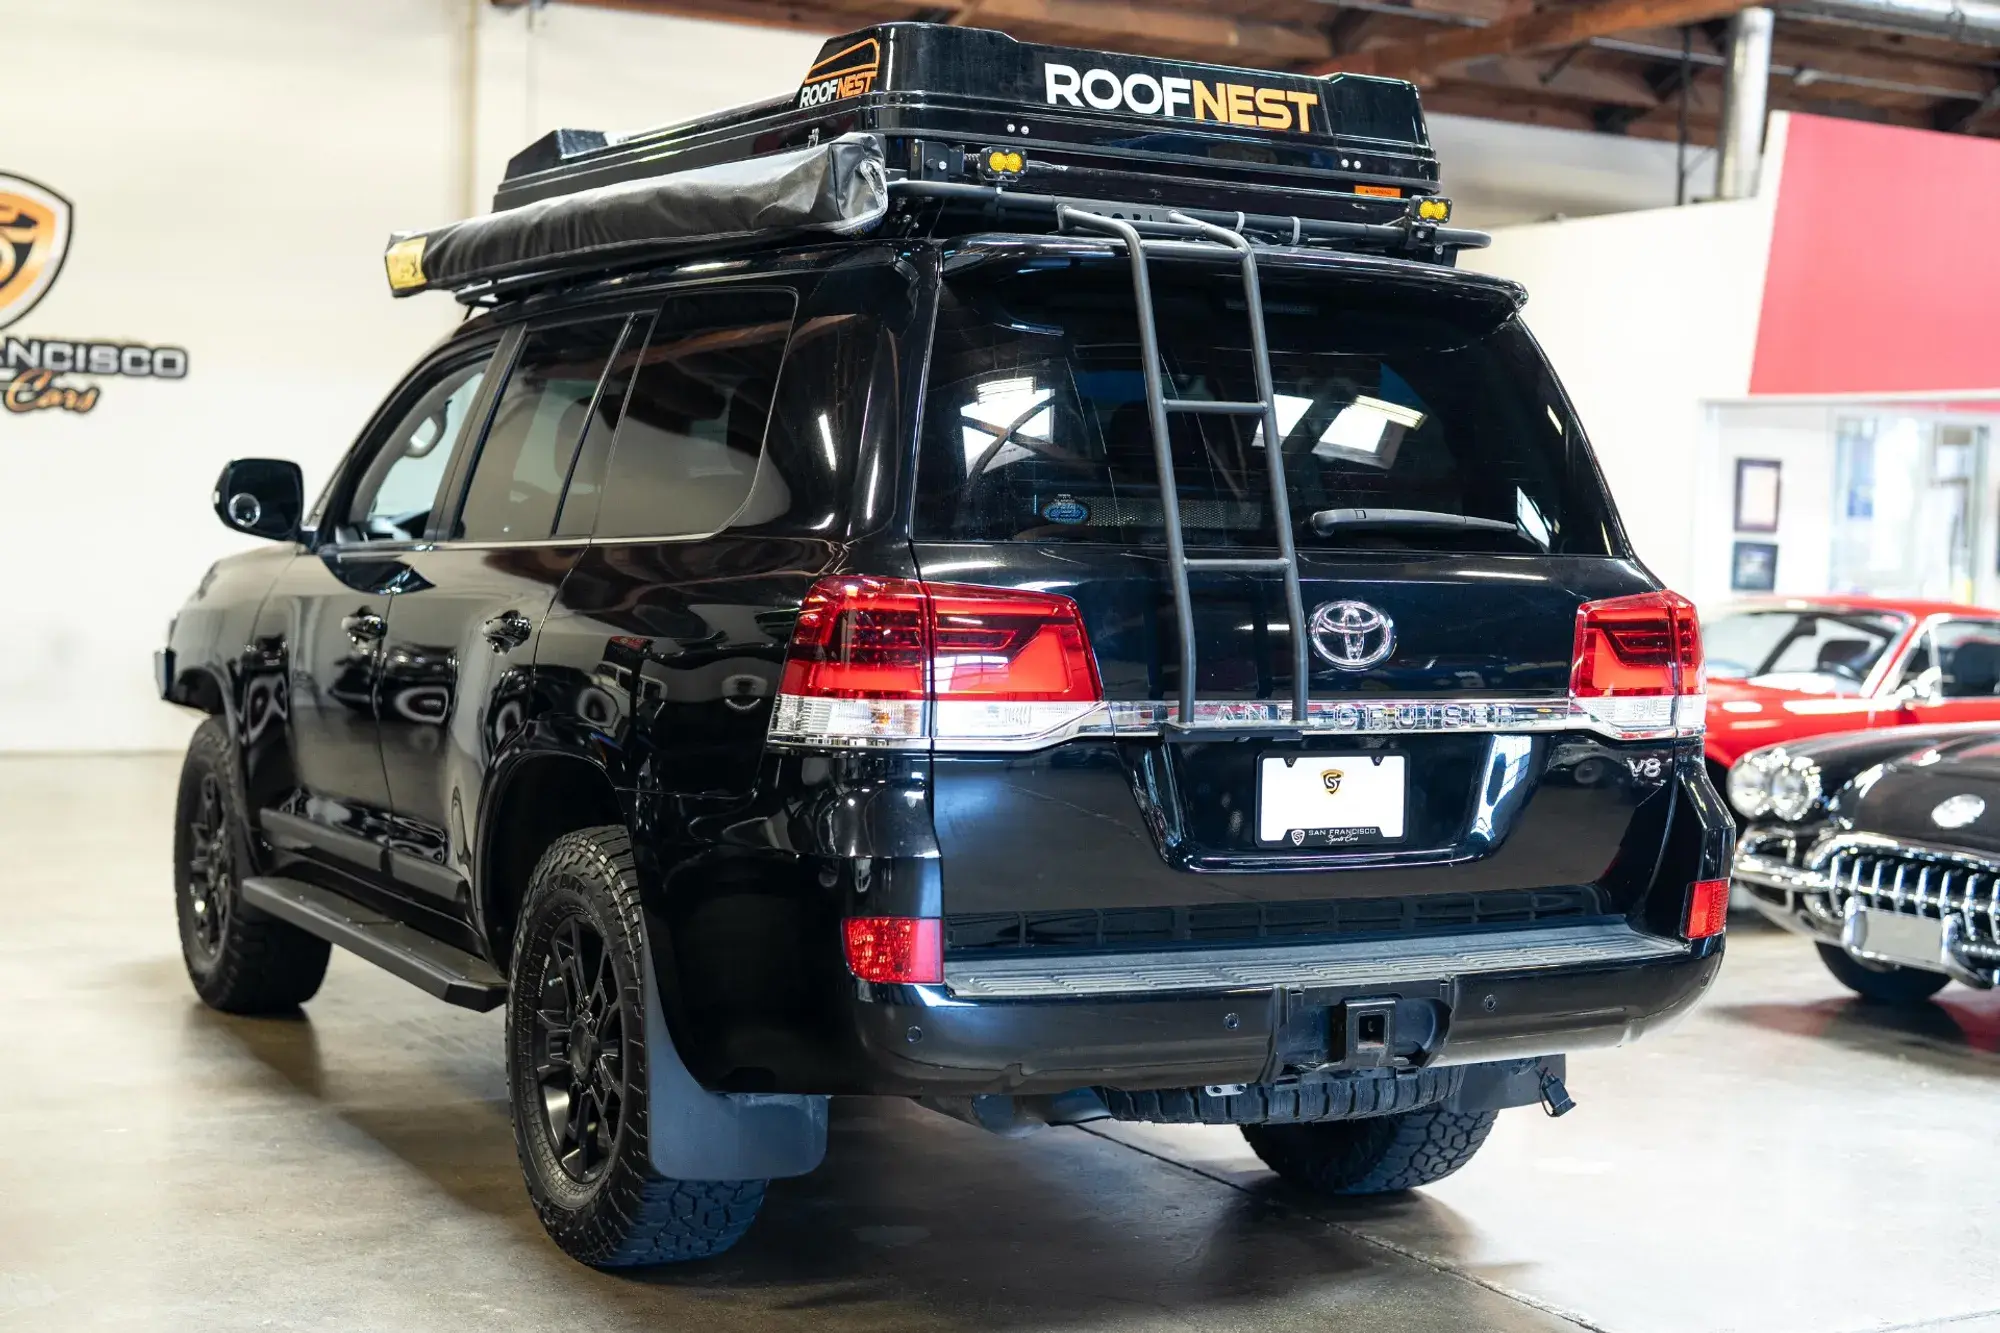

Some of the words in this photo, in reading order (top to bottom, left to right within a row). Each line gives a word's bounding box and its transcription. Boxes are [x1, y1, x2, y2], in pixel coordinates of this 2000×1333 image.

[799, 70, 878, 108] ROOFNEST
[1045, 62, 1318, 133] ROOFNEST
[0, 338, 188, 377] NCISCO
[4, 367, 100, 412] Cars
[1333, 703, 1515, 730] CRUISER
[1626, 757, 1661, 777] V8
[1329, 828, 1376, 836] FRANCISCO
